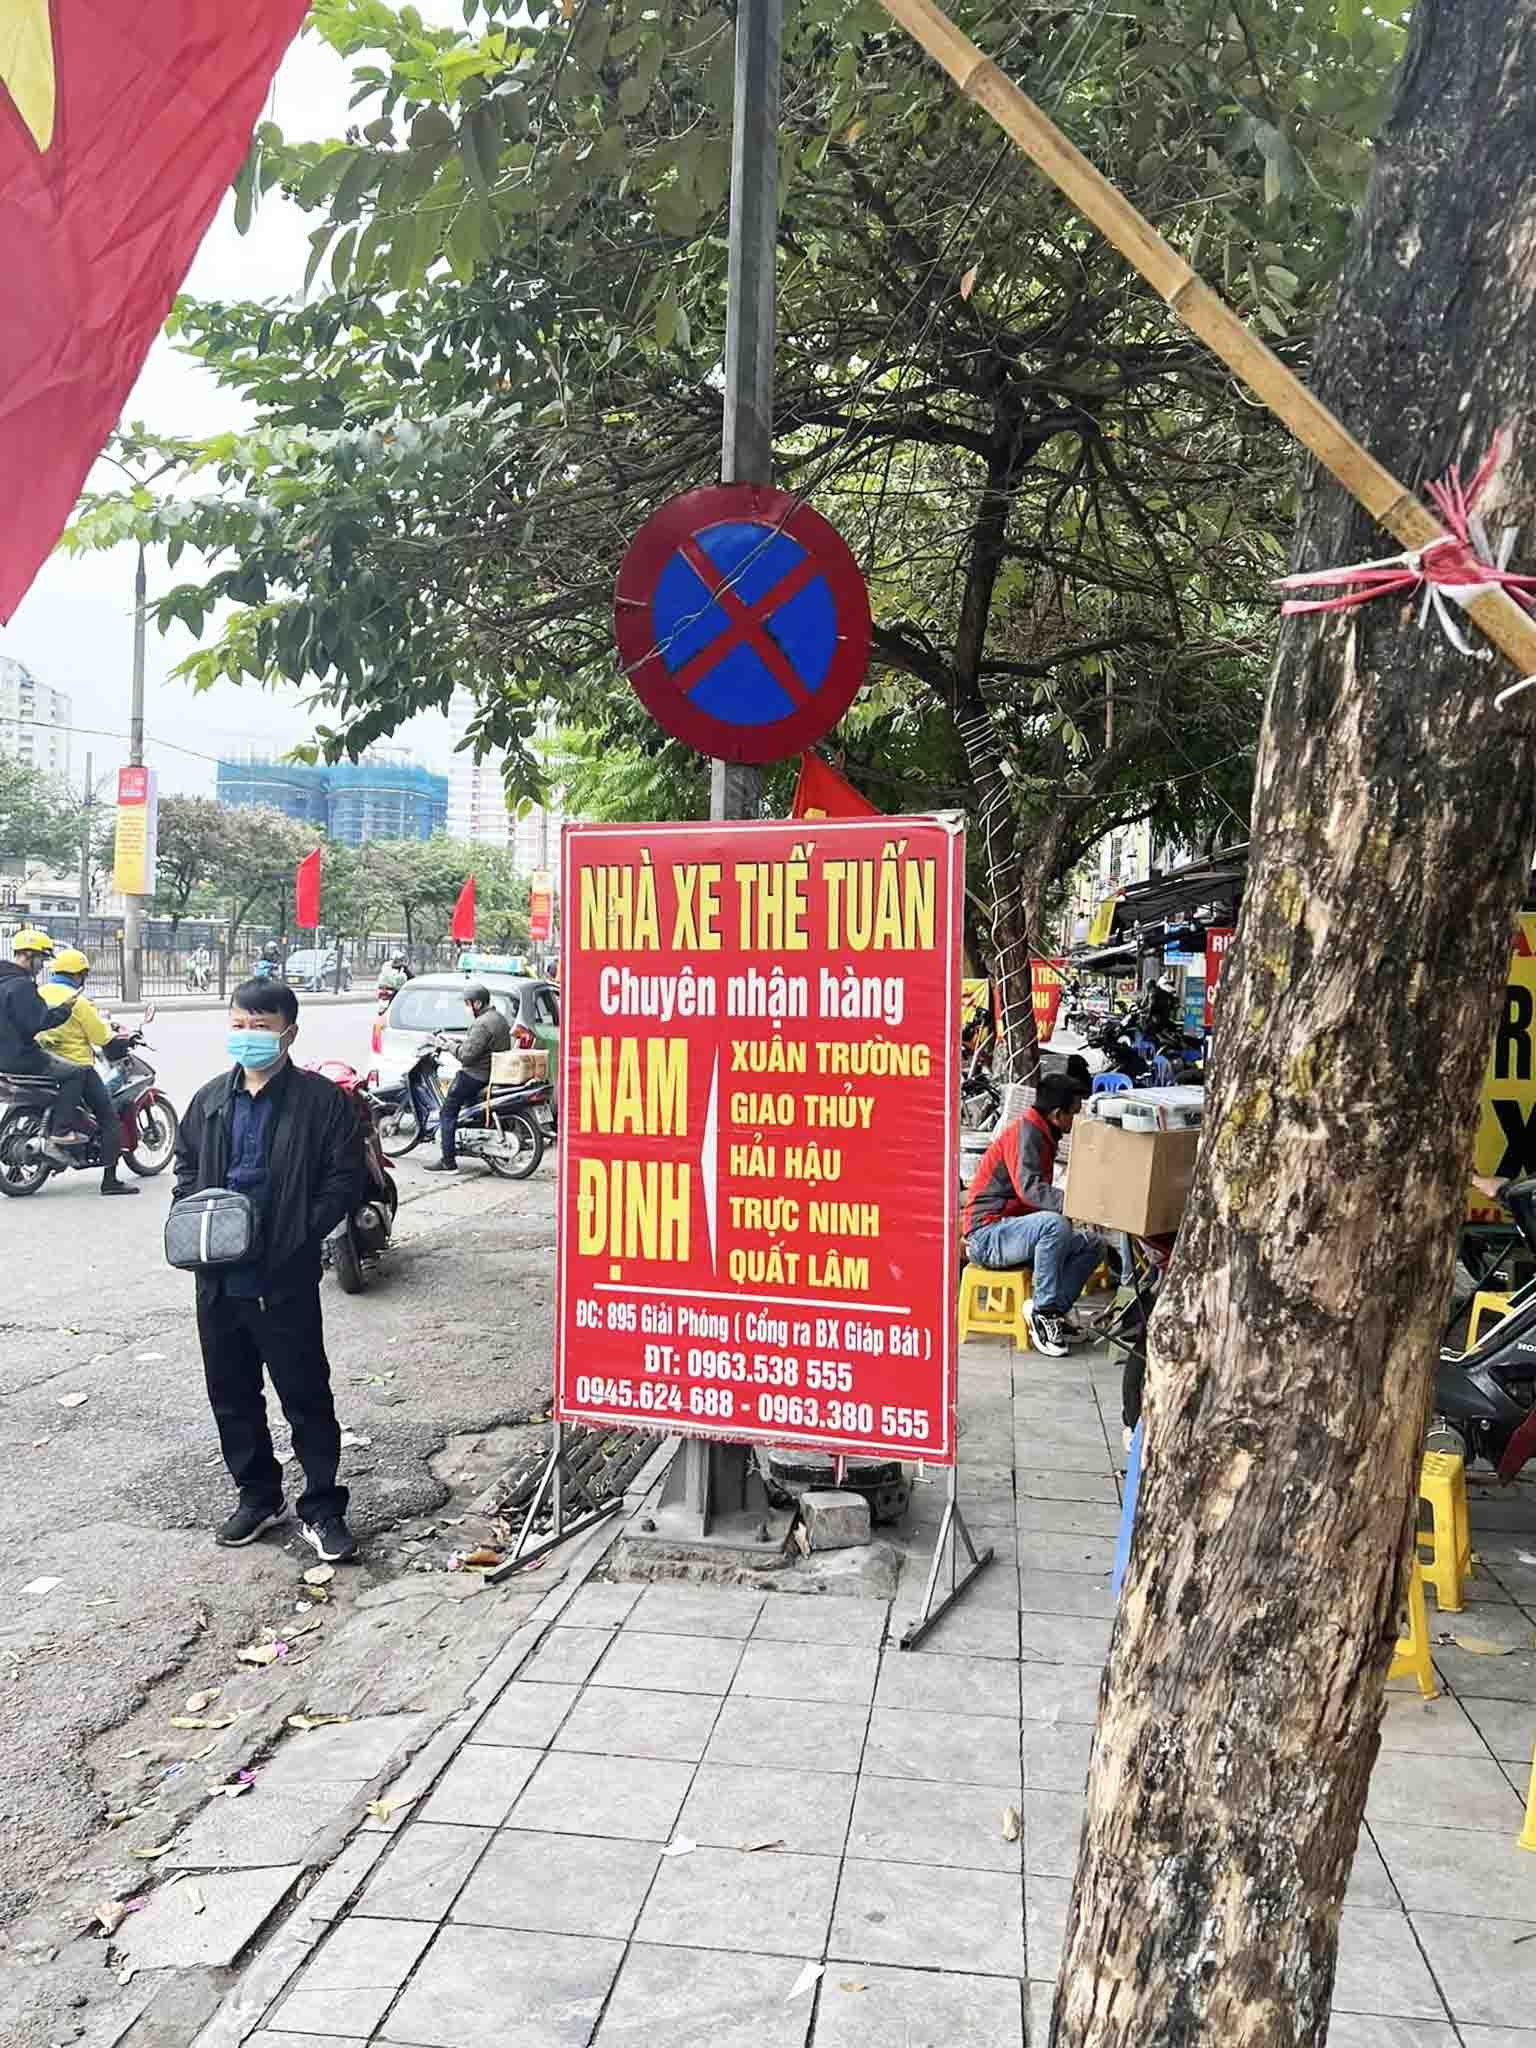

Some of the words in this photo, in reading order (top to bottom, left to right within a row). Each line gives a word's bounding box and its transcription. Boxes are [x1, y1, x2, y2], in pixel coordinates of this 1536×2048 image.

[580, 848, 660, 951] NHÀ
[672, 863, 722, 951] XE
[735, 841, 816, 951] THẾ
[823, 840, 936, 951] TUẤN
[599, 965, 716, 1023] Chuyên
[727, 967, 807, 1029] nhận
[819, 966, 904, 1025] hàng
[730, 1035, 806, 1074] XUÂN
[816, 1035, 931, 1077] TRƯỜNG
[580, 1036, 689, 1136] NAM
[730, 1092, 795, 1126] GIAO
[805, 1082, 876, 1129] THỦY
[730, 1133, 776, 1178] HẢI
[784, 1145, 841, 1185] HẬU
[577, 1159, 691, 1281] ĐỊNH
[729, 1196, 799, 1240] TRỰC
[808, 1203, 880, 1236] NINH
[729, 1240, 800, 1285] QUẤT
[808, 1250, 870, 1291] LÂM
[576, 1299, 603, 1328] ĐC:
[607, 1304, 637, 1331] 895
[641, 1302, 673, 1335] Giải
[678, 1309, 729, 1343] Phóng
[745, 1308, 787, 1347] Cổng
[793, 1322, 811, 1347] ra
[816, 1319, 839, 1350] BX
[845, 1319, 883, 1357] Giáp
[889, 1323, 919, 1354] Bát
[644, 1345, 680, 1376] ĐT:
[688, 1350, 799, 1385] 0963.538
[806, 1360, 852, 1392] 555
[576, 1376, 682, 1412] 0945.624
[689, 1387, 733, 1417] 688
[741, 1403, 750, 1412] -
[758, 1393, 873, 1433] 0963.380
[881, 1406, 929, 1439] 555
